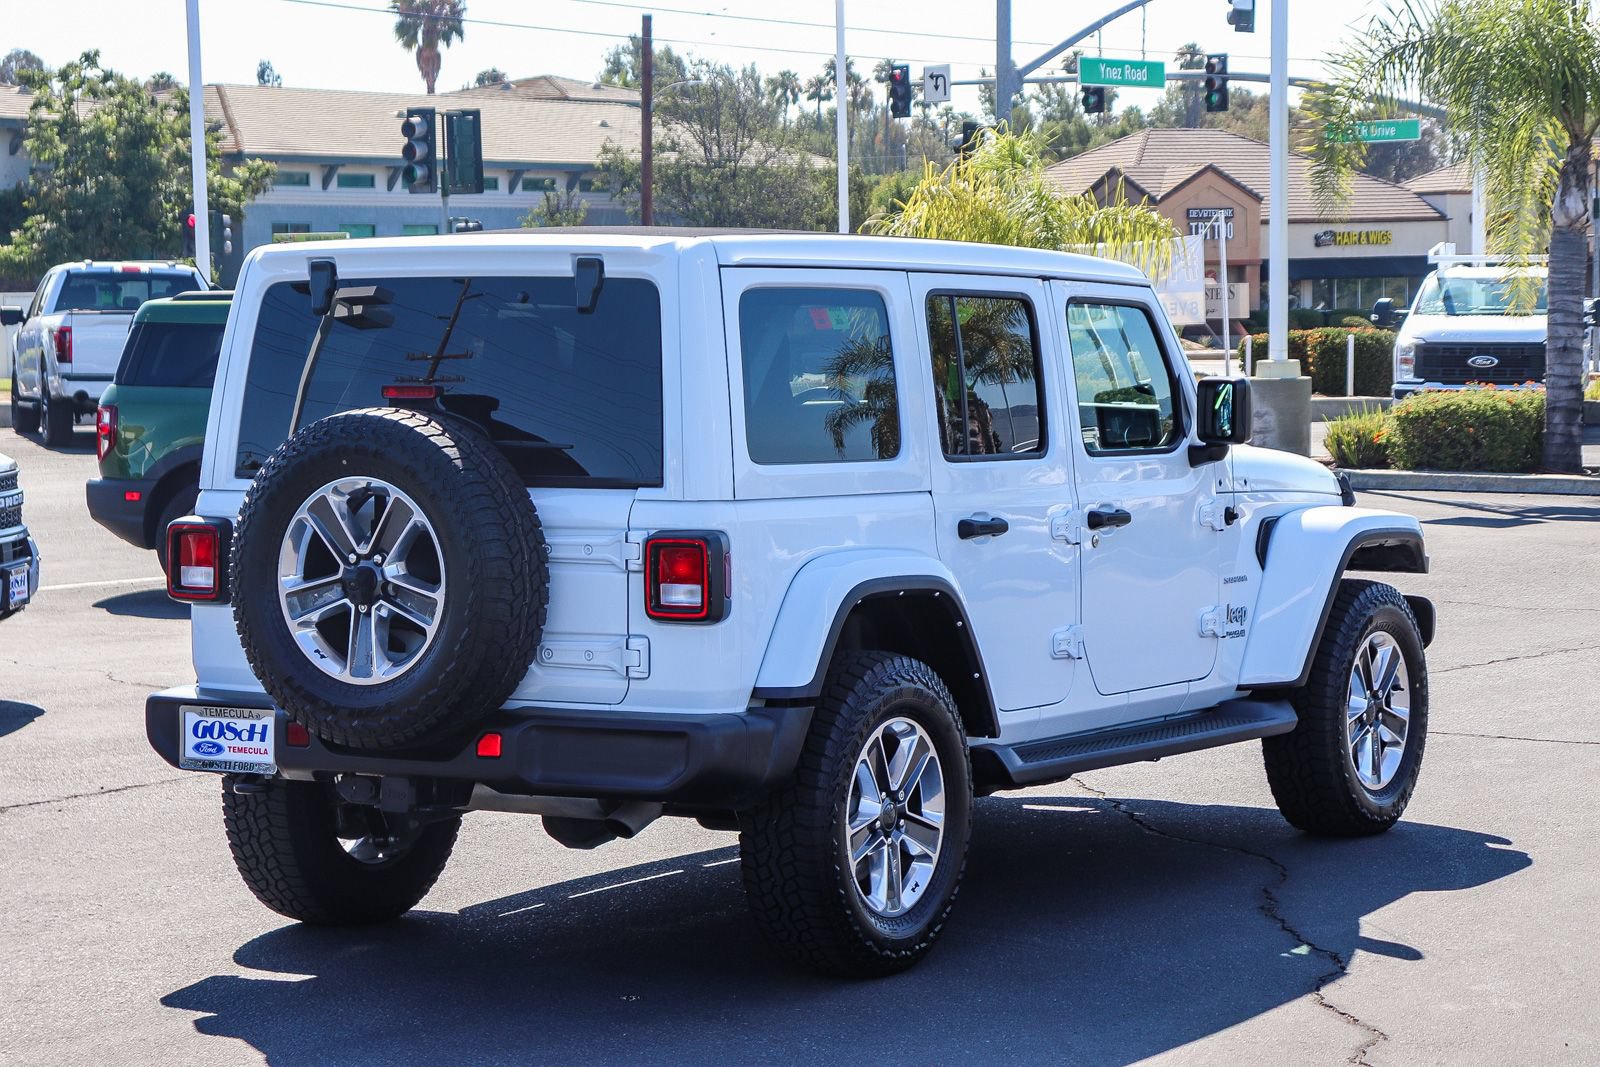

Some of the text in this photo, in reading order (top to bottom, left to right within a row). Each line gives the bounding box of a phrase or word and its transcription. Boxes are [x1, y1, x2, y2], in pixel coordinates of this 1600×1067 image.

[1100, 63, 1147, 81] Ynez Road
[1371, 124, 1396, 137] Drive
[1190, 221, 1233, 239] TATTO
[1335, 231, 1358, 246] HAIR
[1360, 231, 1368, 245] &
[1369, 230, 1393, 245] WIGS
[1205, 284, 1236, 301] STES
[1226, 604, 1247, 626] Jeep
[203, 707, 255, 719] TEMECULA
[227, 745, 269, 755] TEMECULA
[233, 761, 255, 772] FORD
